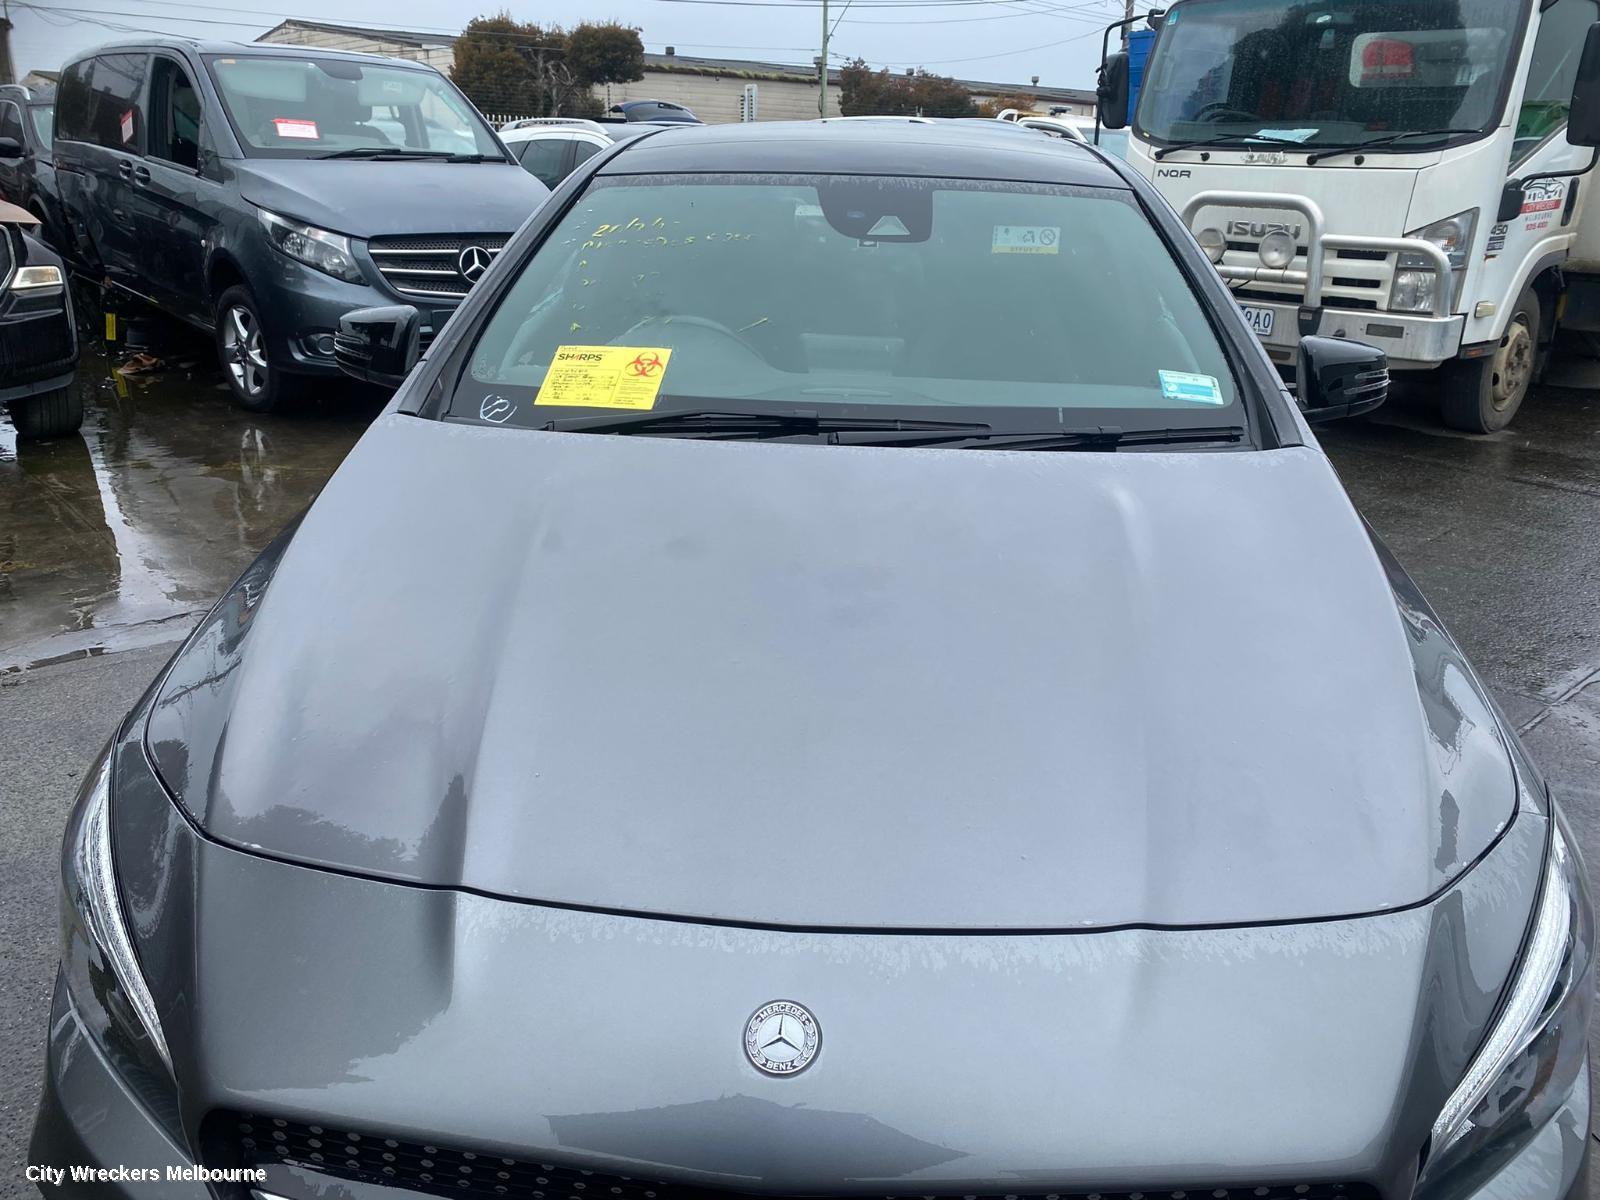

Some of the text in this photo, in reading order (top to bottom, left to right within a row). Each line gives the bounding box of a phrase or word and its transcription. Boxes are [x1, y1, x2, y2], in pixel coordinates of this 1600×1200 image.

[1226, 220, 1302, 240] ISUZU
[1490, 224, 1508, 235] 450
[557, 352, 603, 362] SHARPS
[760, 1004, 809, 1022] MERCEDES
[766, 1061, 793, 1071] BENZ
